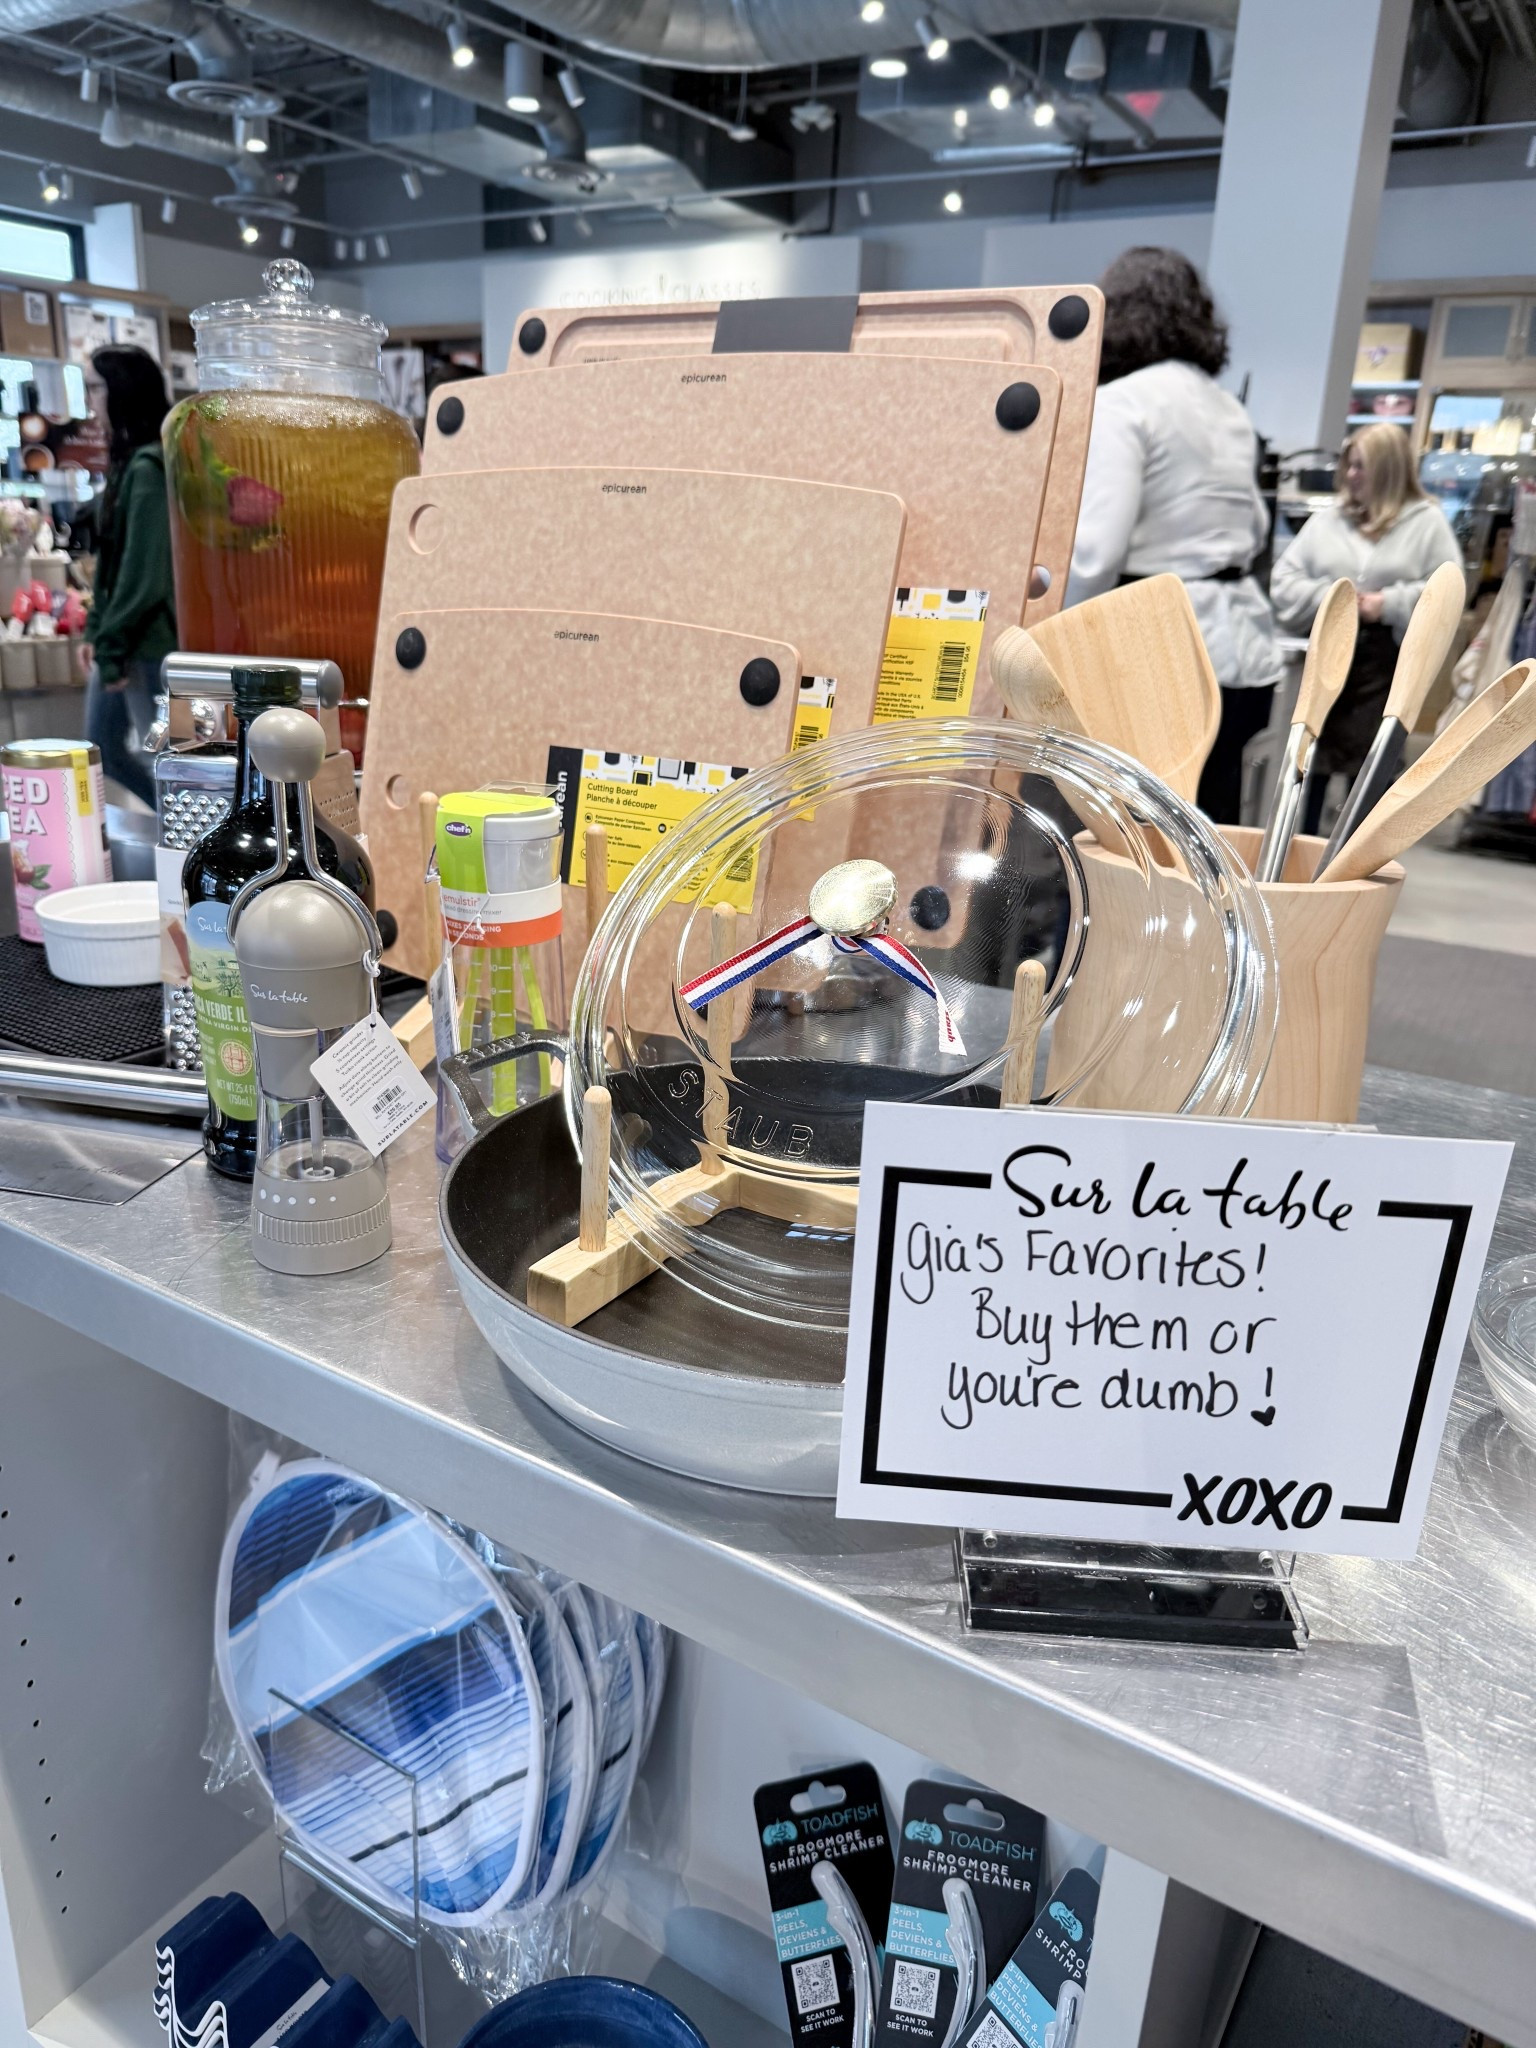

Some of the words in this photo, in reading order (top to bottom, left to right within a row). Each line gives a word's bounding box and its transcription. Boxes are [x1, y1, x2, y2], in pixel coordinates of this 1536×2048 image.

[681, 373, 727, 384] epicurean
[602, 483, 647, 494] epicurean
[553, 629, 600, 642] epicurean
[587, 783, 614, 793] Cutting
[616, 786, 638, 796] Board
[587, 793, 614, 805] Planche
[623, 798, 657, 810] découper
[7, 805, 48, 836] EA
[464, 923, 502, 933] DRESING
[250, 983, 267, 1000] Sur
[268, 990, 279, 1001] la
[278, 990, 309, 1004] table
[205, 999, 234, 1022] VERDE
[213, 1021, 240, 1032] VIRGIN
[376, 1100, 428, 1146] SURLATABLE.COM
[668, 1068, 814, 1159] STAUB
[1002, 1145, 1111, 1218] Sur
[1132, 1161, 1191, 1218] la
[1203, 1157, 1353, 1231] table
[1026, 1226, 1267, 1292] Favorites!
[971, 1287, 1052, 1365] Buy
[1065, 1300, 1187, 1351] them
[1210, 1316, 1277, 1354] or
[941, 1362, 1082, 1429] you're
[1177, 1472, 1333, 1531] XOXO
[801, 1803, 879, 1835] TOADFISH
[769, 1851, 819, 1873] SHRIMP
[824, 1834, 885, 1859] CLEANER
[788, 1829, 863, 1857] FROGMORE
[949, 1830, 1034, 1862] TOADFISH
[927, 1849, 1009, 1875] FROGMORE
[903, 1856, 957, 1876] SHRIMP
[963, 1869, 1032, 1892] CLEANER
[776, 1909, 799, 1921] 3-in-1
[894, 1906, 919, 1917] 3-in-1
[777, 1919, 808, 1934] PEELS,
[779, 1929, 819, 1946] DEVIENS
[820, 1926, 827, 1934] &
[892, 1919, 924, 1933] PEELS,
[781, 1934, 842, 1958] BUTTERFLIES
[891, 1930, 934, 1947] DEVIENS
[935, 1940, 942, 1948] &
[889, 1943, 954, 1963] BUTTERFLIES
[1035, 1927, 1082, 1979] SHRIMP
[1060, 1940, 1088, 1976] FRO
[1007, 1962, 1030, 1990] 3-in-1
[1001, 1972, 1028, 2007] PEELS,
[806, 2012, 825, 2022] SCAN
[825, 2008, 836, 2016] TO
[996, 1981, 1032, 2023] DEVIENS
[1031, 2023, 1038, 2032] &
[800, 2025, 815, 2033] SEE
[822, 2015, 845, 2026] WORK
[887, 2021, 900, 2030] SEE
[909, 2026, 934, 2037] WORK
[895, 2014, 915, 2024] SCAN
[916, 2018, 928, 2026] TO
